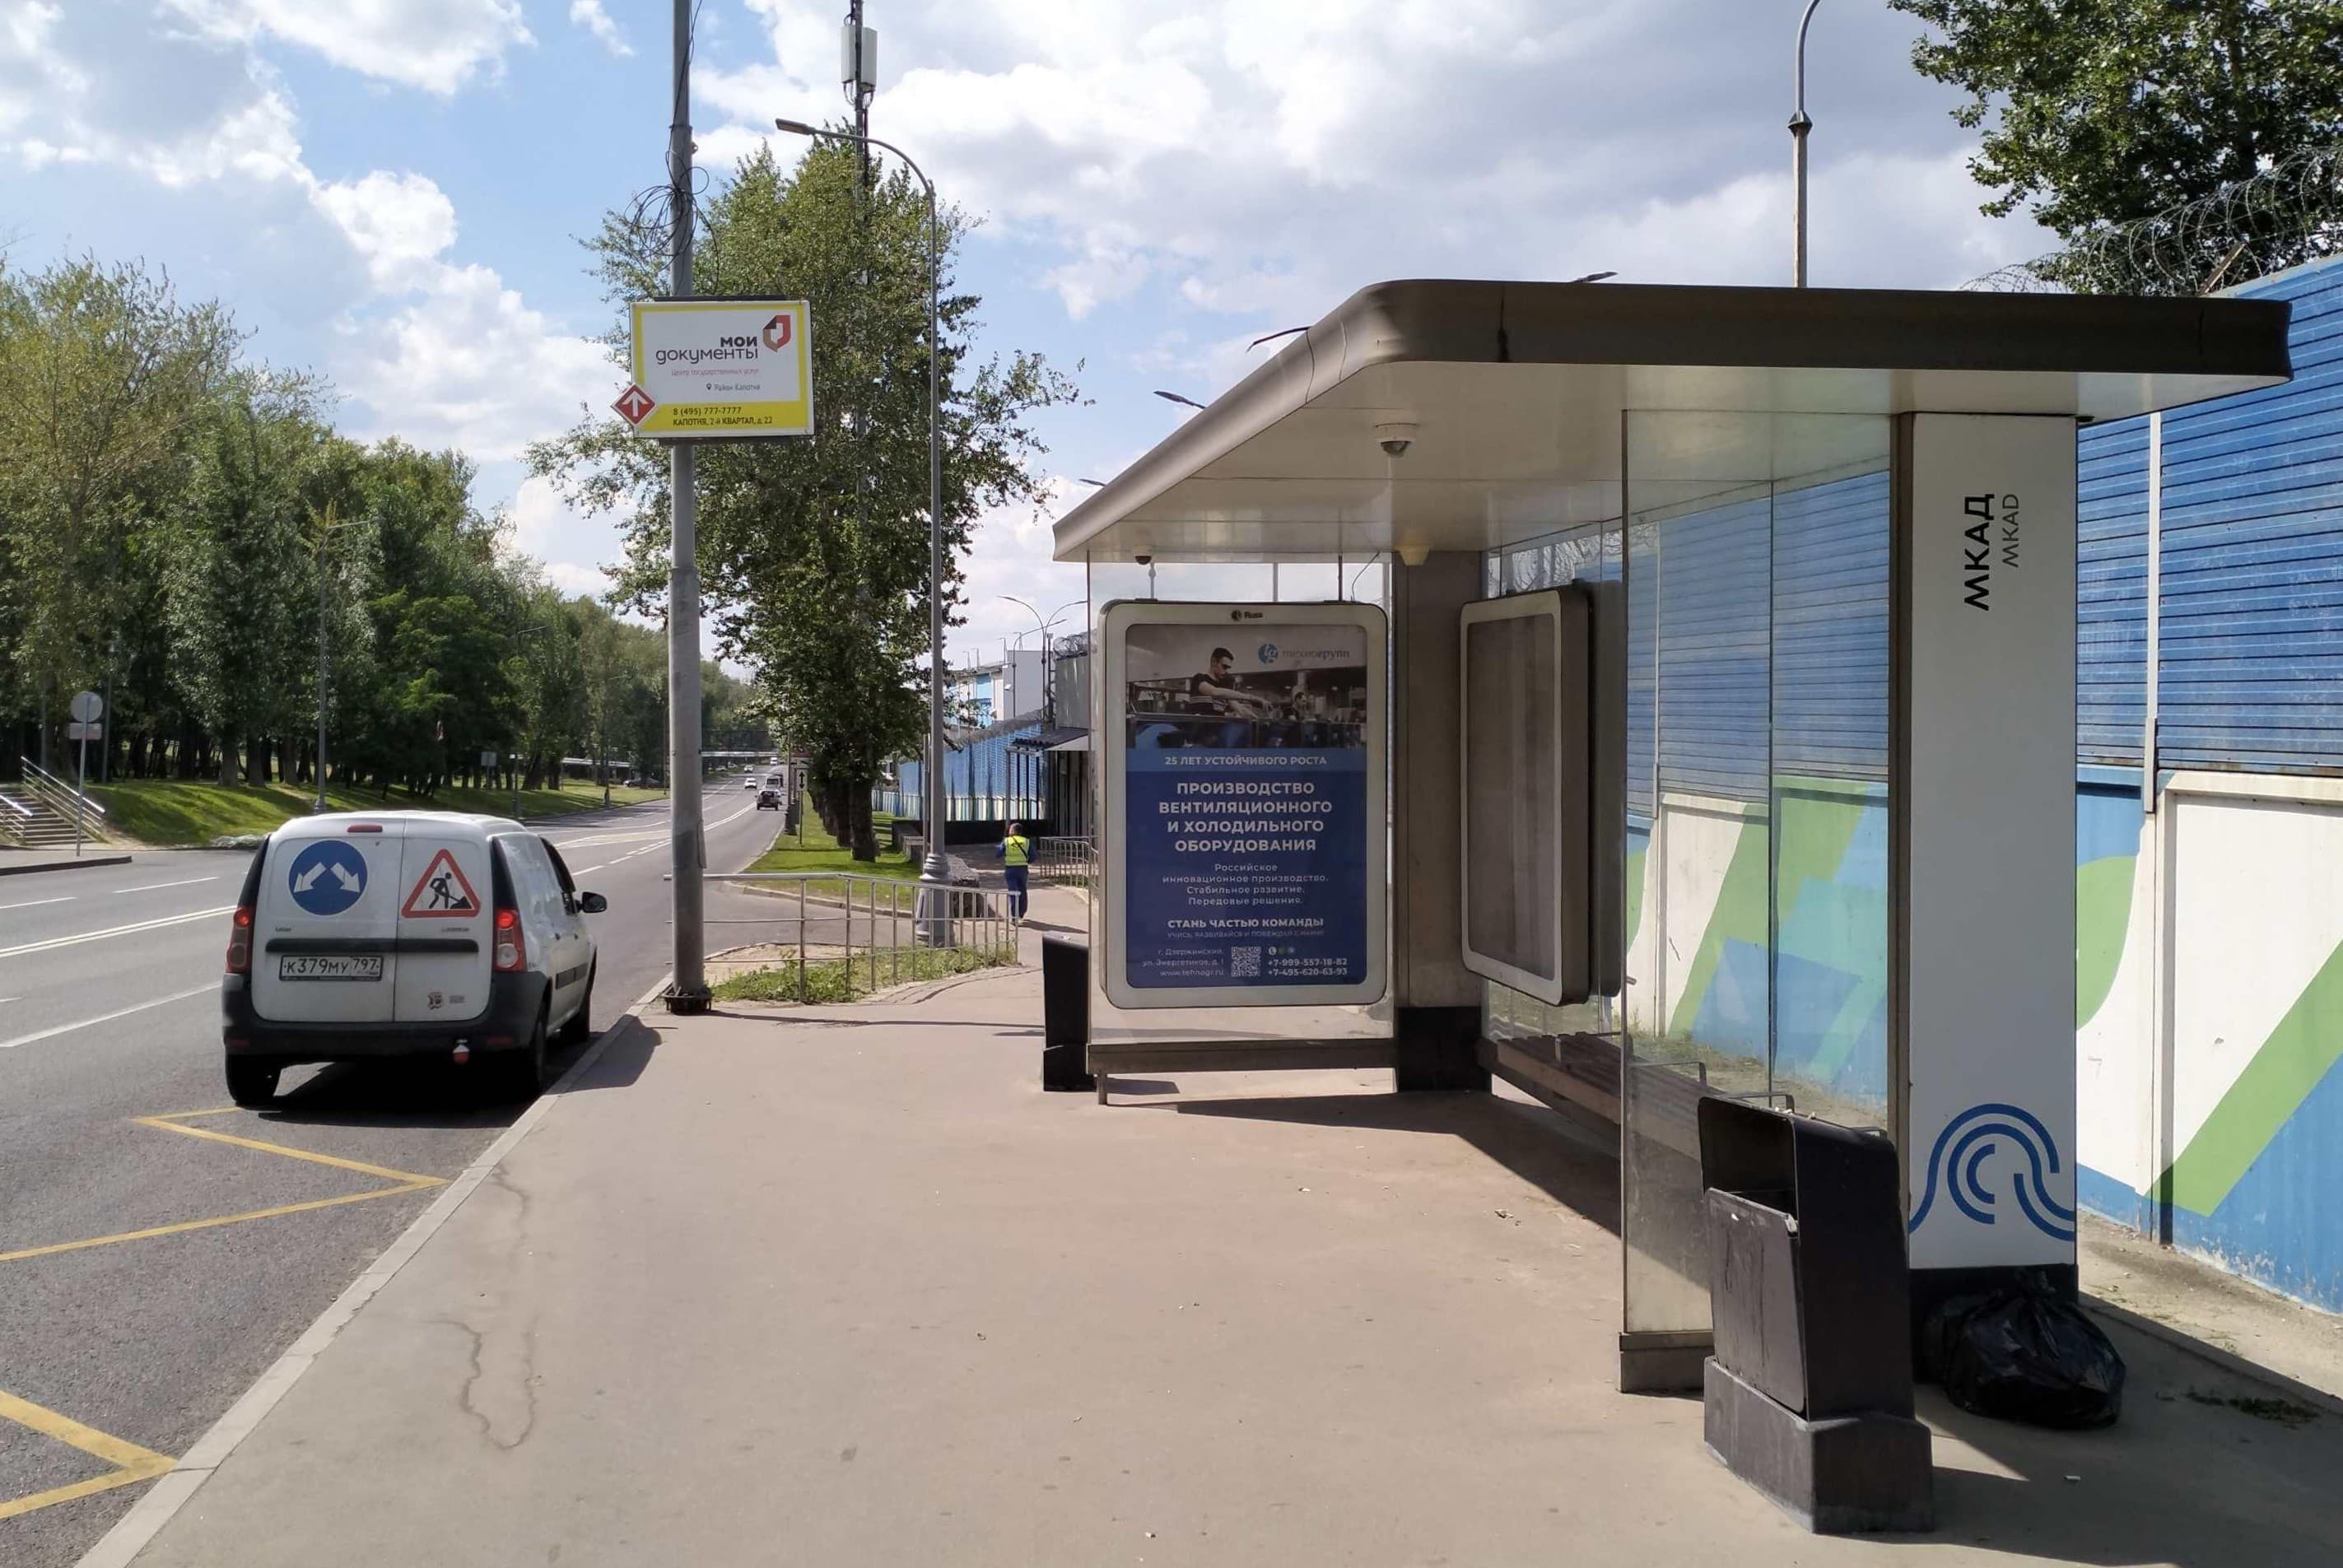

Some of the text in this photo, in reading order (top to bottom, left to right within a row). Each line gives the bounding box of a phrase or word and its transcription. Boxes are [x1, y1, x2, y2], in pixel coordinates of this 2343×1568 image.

[720, 337, 757, 347] мои
[655, 348, 759, 365] документы
[680, 407, 701, 416] (495)
[722, 416, 757, 426] КВАРТАЛ,
[2002, 494, 2019, 568] MKAD
[1963, 494, 1995, 611] МКАД
[1165, 755, 1327, 765] 25 ЛЕТ УСТОЙЧИВОГО РОСТА
[1176, 782, 1315, 795] ПРОИЗВОДСТВО
[1158, 801, 1333, 816] ВЕНТИЛЯЦИОННОГО
[1167, 820, 1324, 835] И ХОЛОДИЛЬНОГО
[1175, 839, 1316, 854] ОБОРУДОВАНИЯ
[1214, 863, 1278, 872] Российское
[1162, 874, 1329, 884] инновационное производство.
[1186, 886, 1305, 895] Стабильное развитие.
[1188, 896, 1303, 906] Передовые решения.
[1167, 918, 1324, 928] СТАНЬ ЧАСТЬЮ КОМАНДЫ
[352, 958, 377, 970] 797
[1268, 958, 1347, 966] +7-999-557-18-82
[1268, 968, 1347, 976] +7-495-620-63-93
